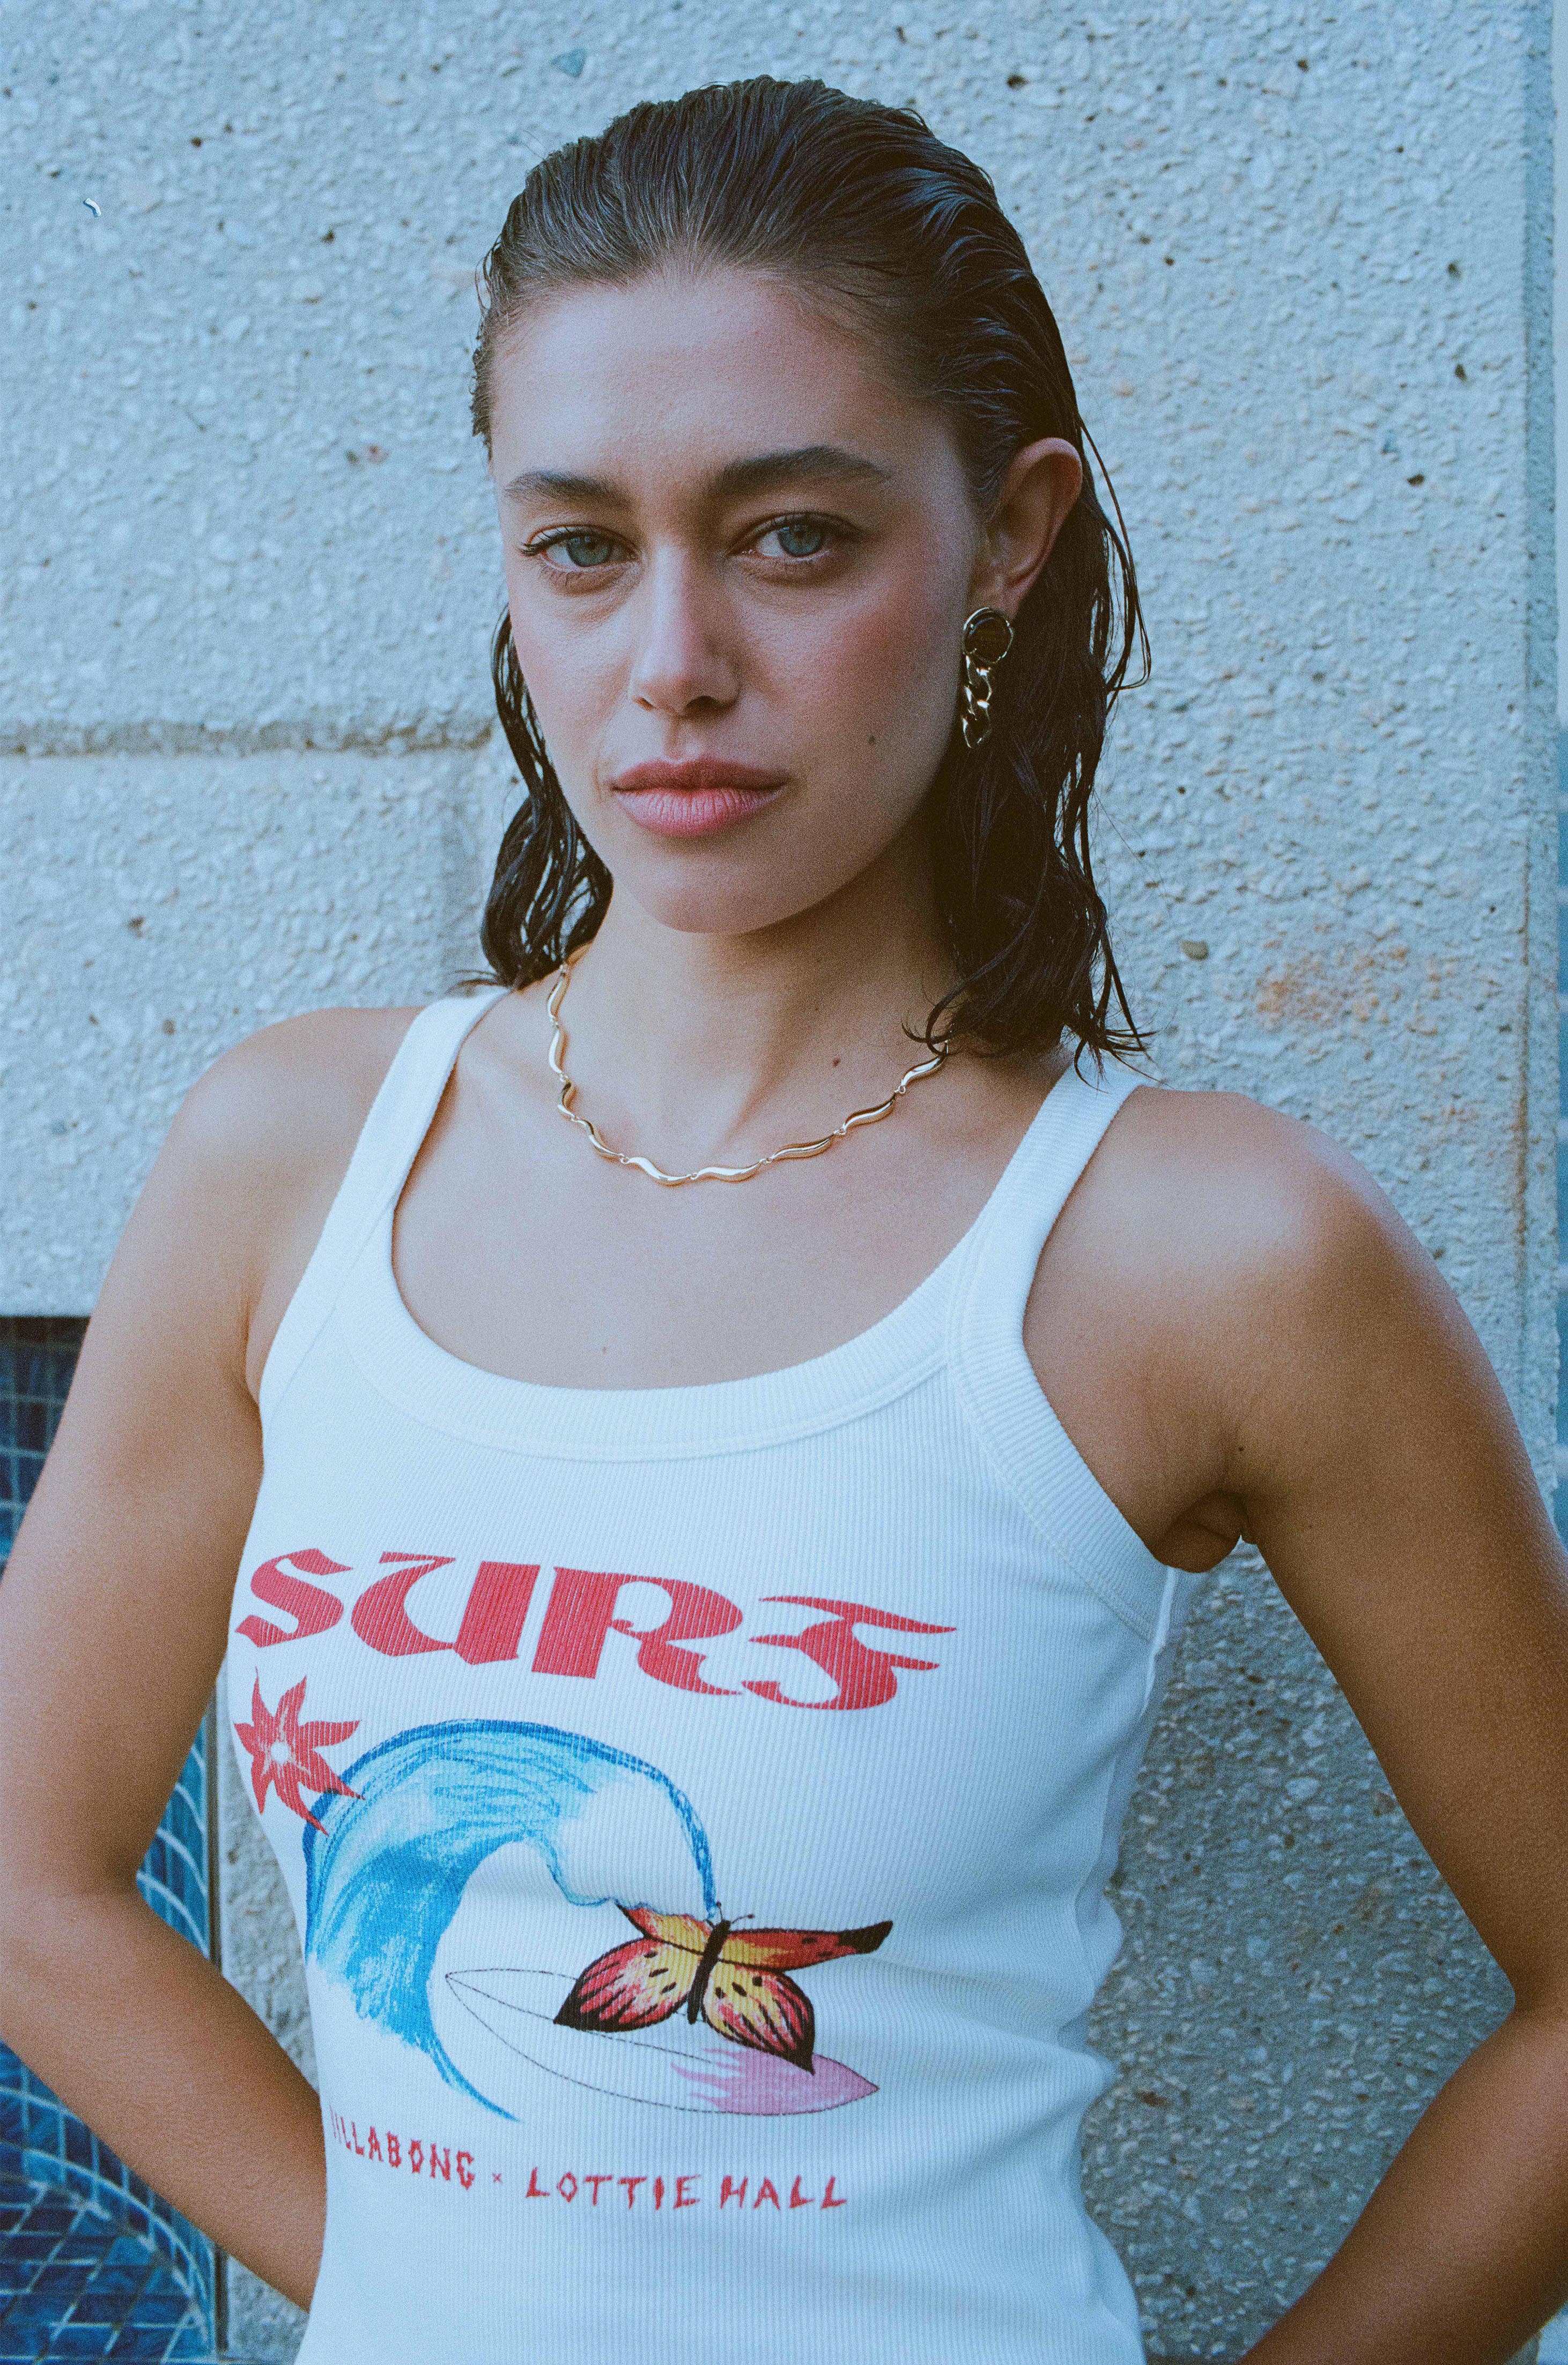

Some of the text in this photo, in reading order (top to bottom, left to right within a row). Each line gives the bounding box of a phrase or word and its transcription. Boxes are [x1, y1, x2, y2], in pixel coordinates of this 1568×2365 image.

[234, 1548, 957, 1711] SURF
[329, 2105, 475, 2190] ILLABONG
[525, 2166, 701, 2211] LOTTIE
[720, 2175, 847, 2210] HALL
